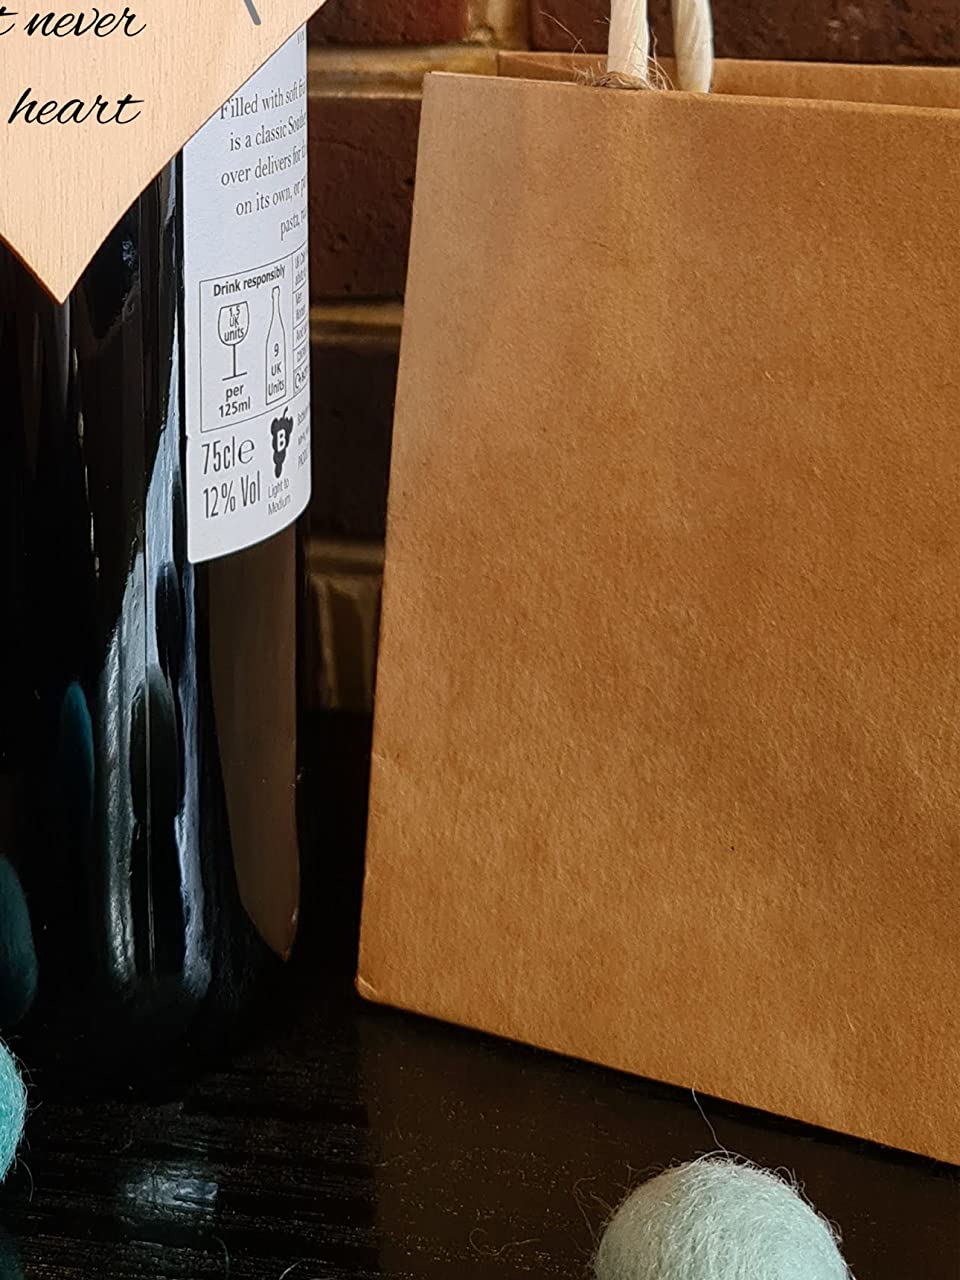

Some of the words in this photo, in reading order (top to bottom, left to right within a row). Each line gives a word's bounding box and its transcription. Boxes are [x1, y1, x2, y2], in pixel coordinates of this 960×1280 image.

[24, 6, 147, 38] never
[7, 87, 146, 126] heart
[220, 93, 258, 120] Filled
[262, 87, 284, 111] with
[229, 131, 241, 152] is
[244, 134, 252, 148] a
[255, 119, 287, 146] classic
[221, 167, 251, 186] over
[254, 154, 292, 179] delivers
[235, 200, 252, 216] on
[256, 191, 270, 211] its
[213, 278, 241, 297] Drink
[243, 263, 286, 289] responsibly
[224, 327, 245, 342] units
[273, 343, 280, 358] 9
[271, 361, 282, 377] UK
[225, 384, 244, 402] per
[268, 379, 285, 397] Units
[218, 395, 251, 418] 125ml
[277, 428, 286, 452] B
[202, 480, 236, 519] 12%
[240, 470, 261, 507] Vol
